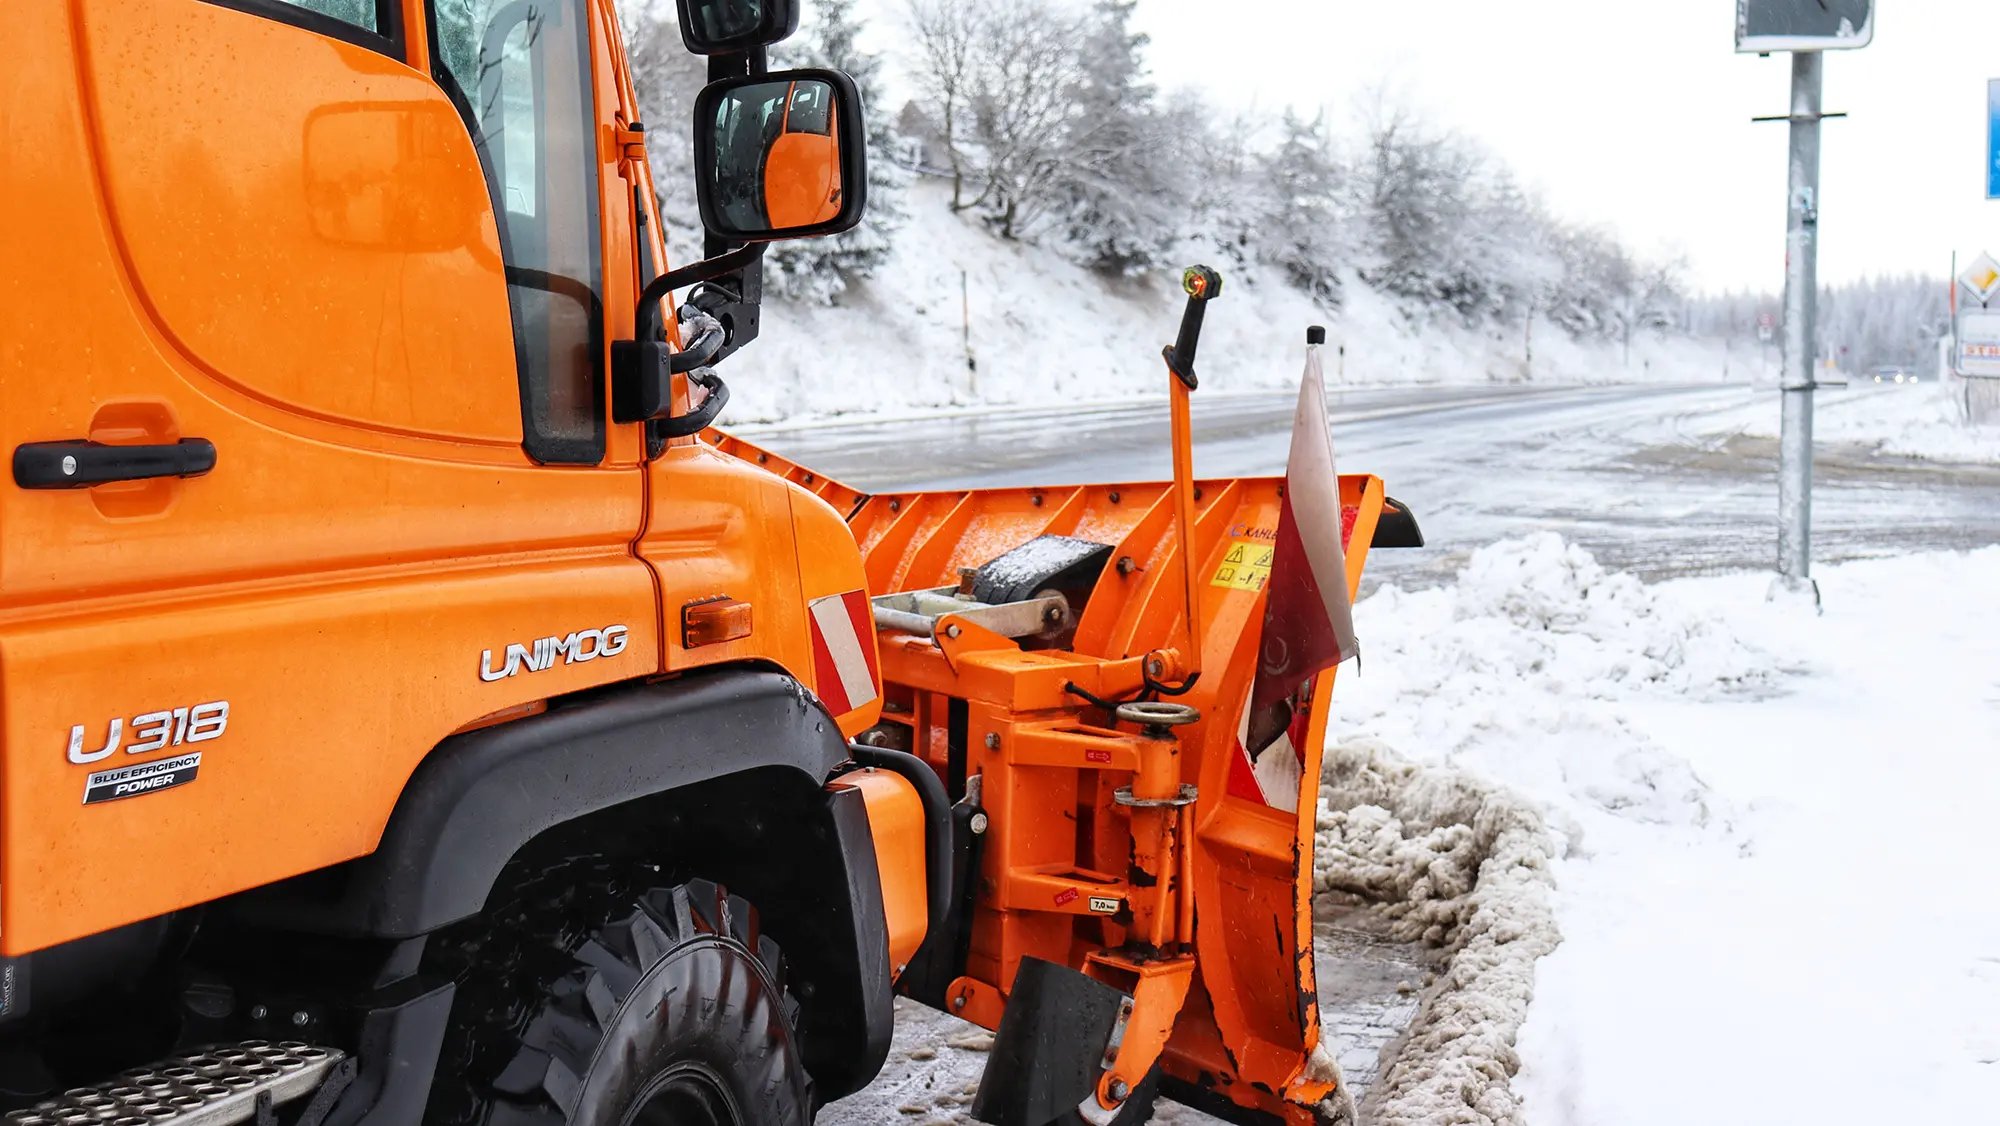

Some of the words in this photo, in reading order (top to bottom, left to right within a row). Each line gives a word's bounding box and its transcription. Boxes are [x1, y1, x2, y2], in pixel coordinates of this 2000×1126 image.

[480, 624, 629, 682] UNIMOG
[68, 718, 123, 764] U
[126, 700, 230, 754] 318
[94, 770, 128, 785] BLUE
[130, 755, 199, 777] EFFICIENCY
[115, 773, 175, 796] POWER
[1094, 901, 1106, 909] 7,0
